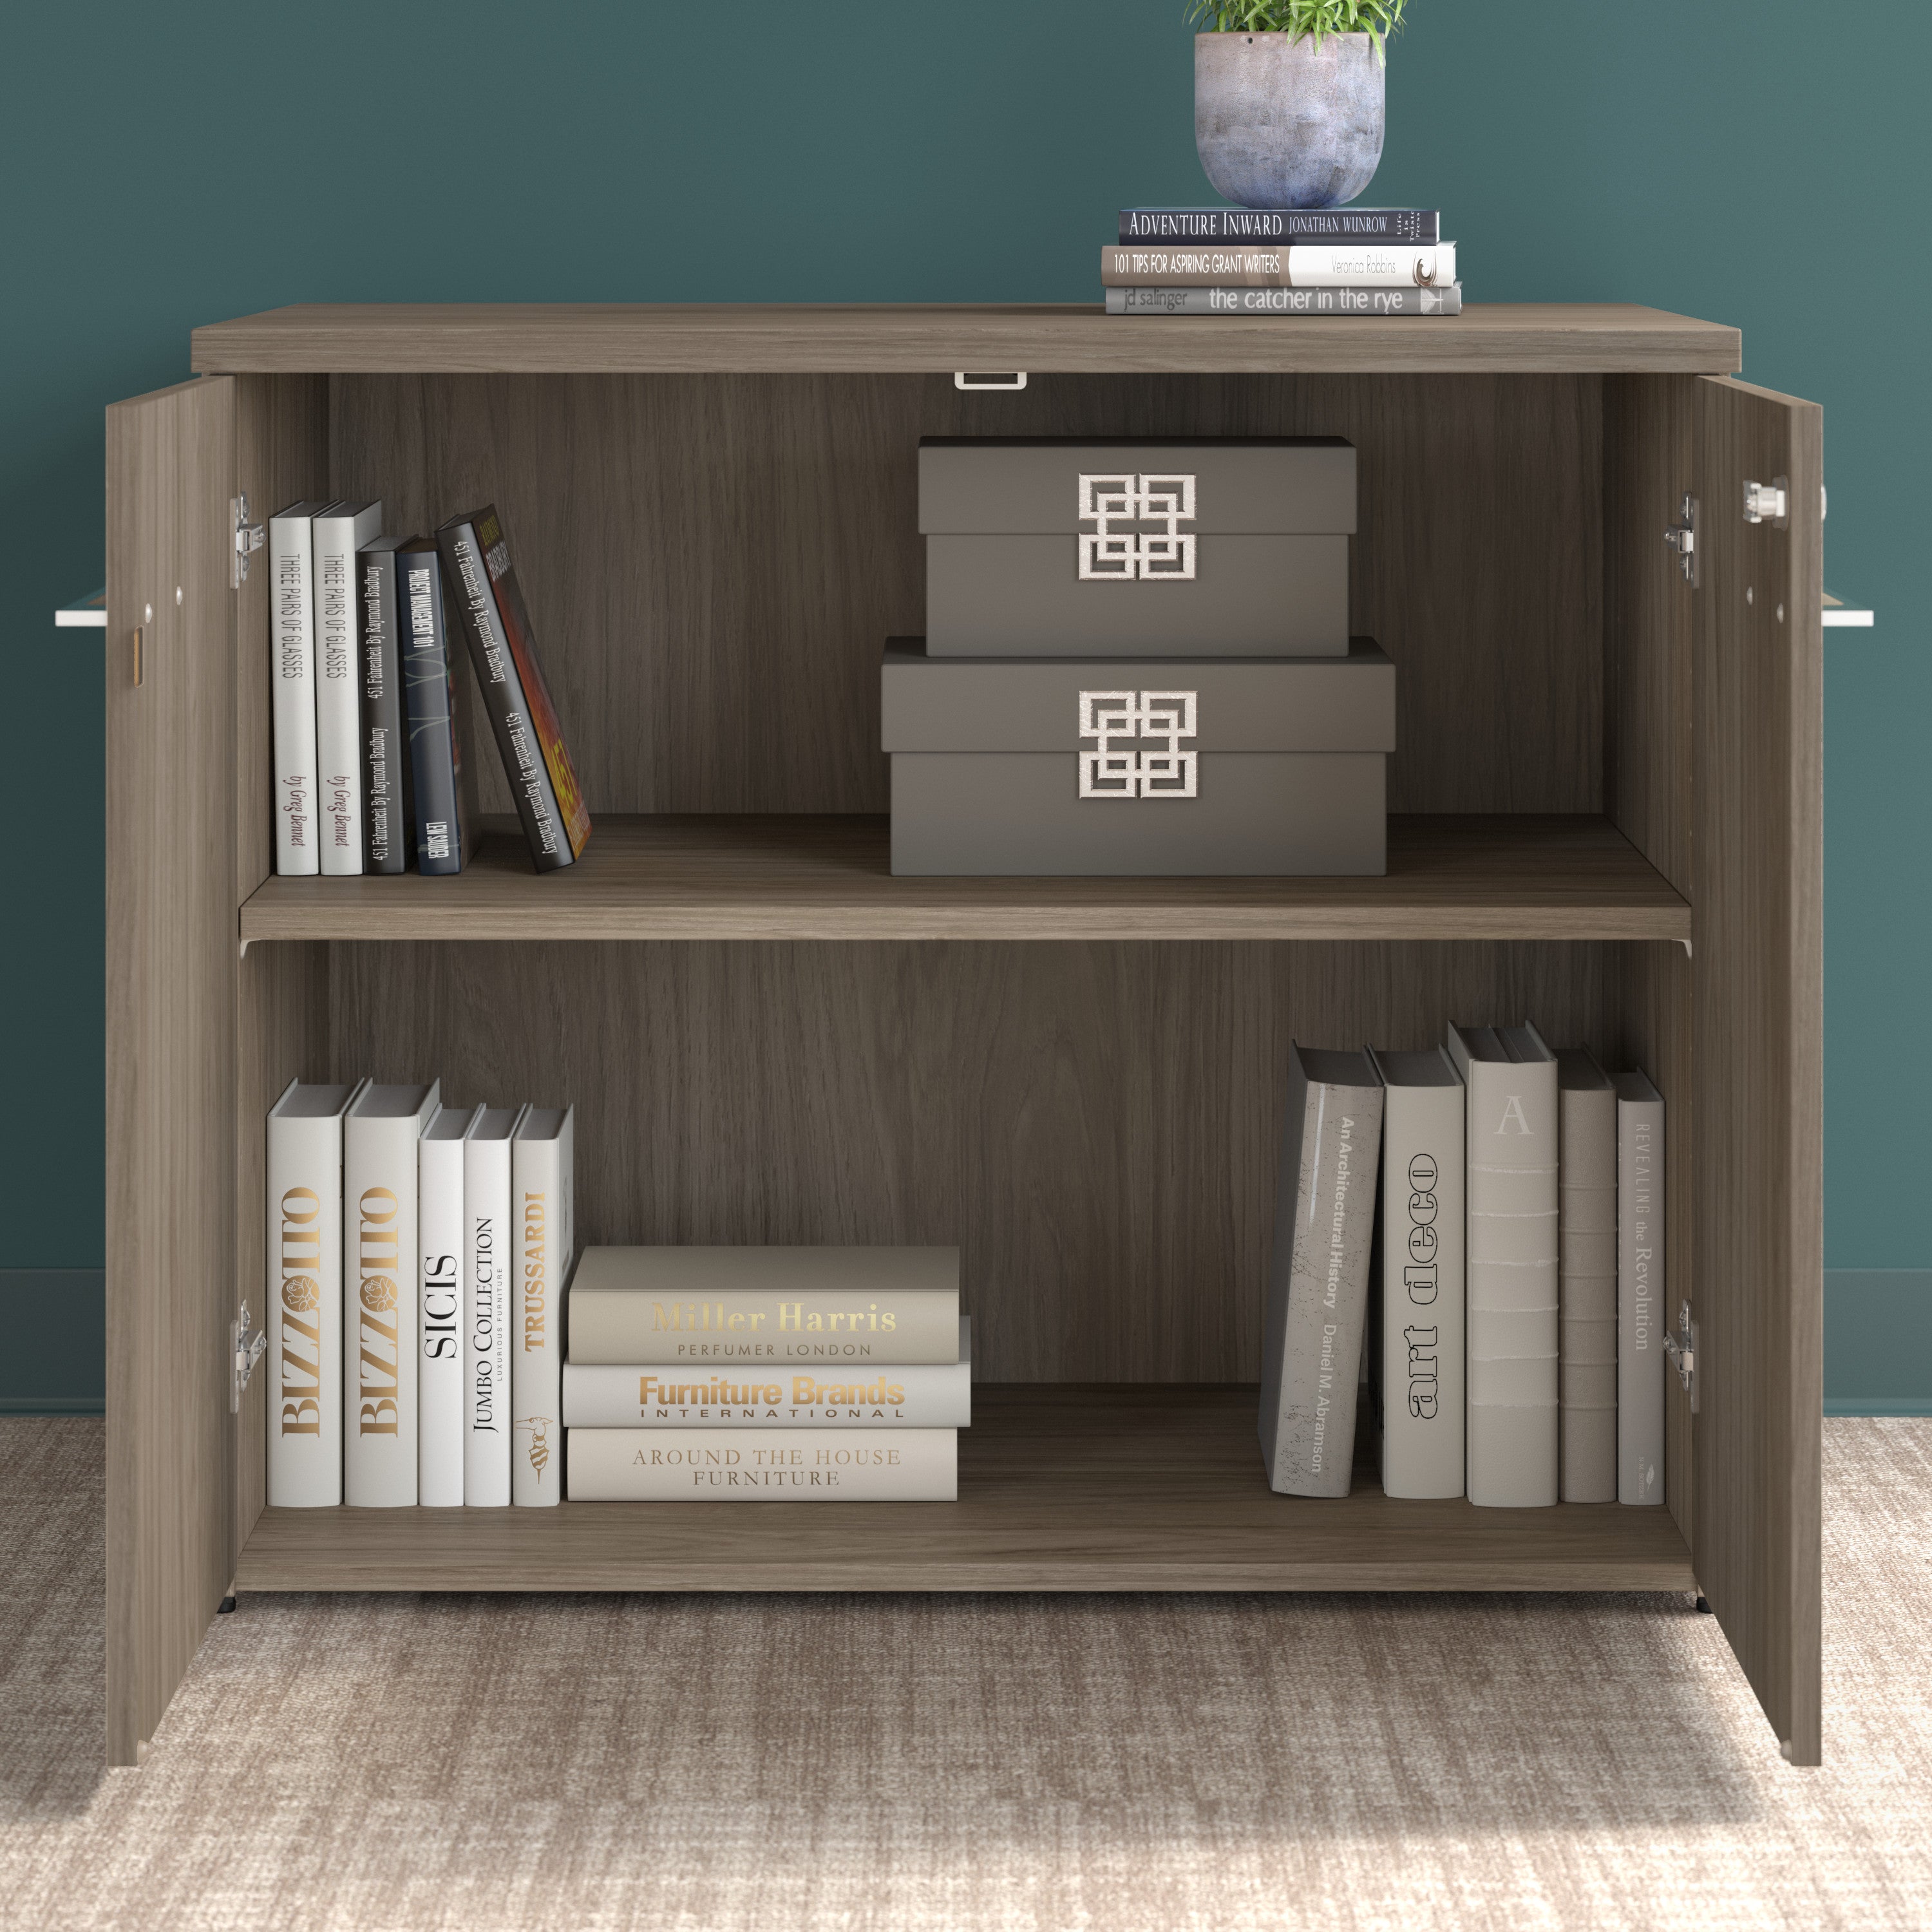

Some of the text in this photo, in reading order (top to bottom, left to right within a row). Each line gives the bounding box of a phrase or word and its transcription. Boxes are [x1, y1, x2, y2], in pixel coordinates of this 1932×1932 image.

[1129, 212, 1282, 235] ADVENTURE INWARD
[1289, 216, 1387, 234] JONATHAN WUNROW
[1114, 254, 1280, 273] 101 TIPS FOR ASPIRING GRANT WRITERS
[1331, 253, 1396, 274] Veronica Robbins
[1124, 288, 1187, 312] jd salinger
[1209, 287, 1403, 314] the catcher in the rye
[486, 539, 511, 582] BRADBURY
[280, 554, 303, 678] THREE PAIRS OF GLASSES
[325, 554, 346, 678] THREE PAIRS OF GLASSES
[365, 566, 385, 699] 451 Fahrenheit By Raymond Bradbury
[408, 569, 434, 648] PROJECT MANAGEMENT 101
[454, 541, 506, 683] 451 Fahrenheit By Raymond Bradbury
[283, 776, 307, 847] by Greg Bennet
[327, 776, 352, 847] by Greg Bennet
[369, 728, 391, 860] 451 Fahrenheit By Raymond Bradbury
[506, 712, 558, 854] 451 Fahrenheit By Raymond Bradbury
[1494, 1095, 1534, 1135] A
[1323, 1117, 1354, 1310] An Architectural History
[1635, 1123, 1652, 1351] REVEALING the Revolution
[424, 1255, 457, 1359] SICIS
[524, 1192, 545, 1352] TRUSSARDI
[1403, 1153, 1438, 1419] art deco
[473, 1217, 498, 1433] JUMBO COLLECTION
[651, 1303, 896, 1332] Miller Harris
[678, 1344, 871, 1356] PERFUMER LONDON
[639, 1376, 905, 1405] Furniture Brands
[641, 1409, 904, 1417] INTERNATIONAL
[1312, 1324, 1336, 1473] Daniel M. Abramson
[632, 1450, 901, 1465] AROUND THE HOUSE
[693, 1471, 840, 1486] FURNITURE
